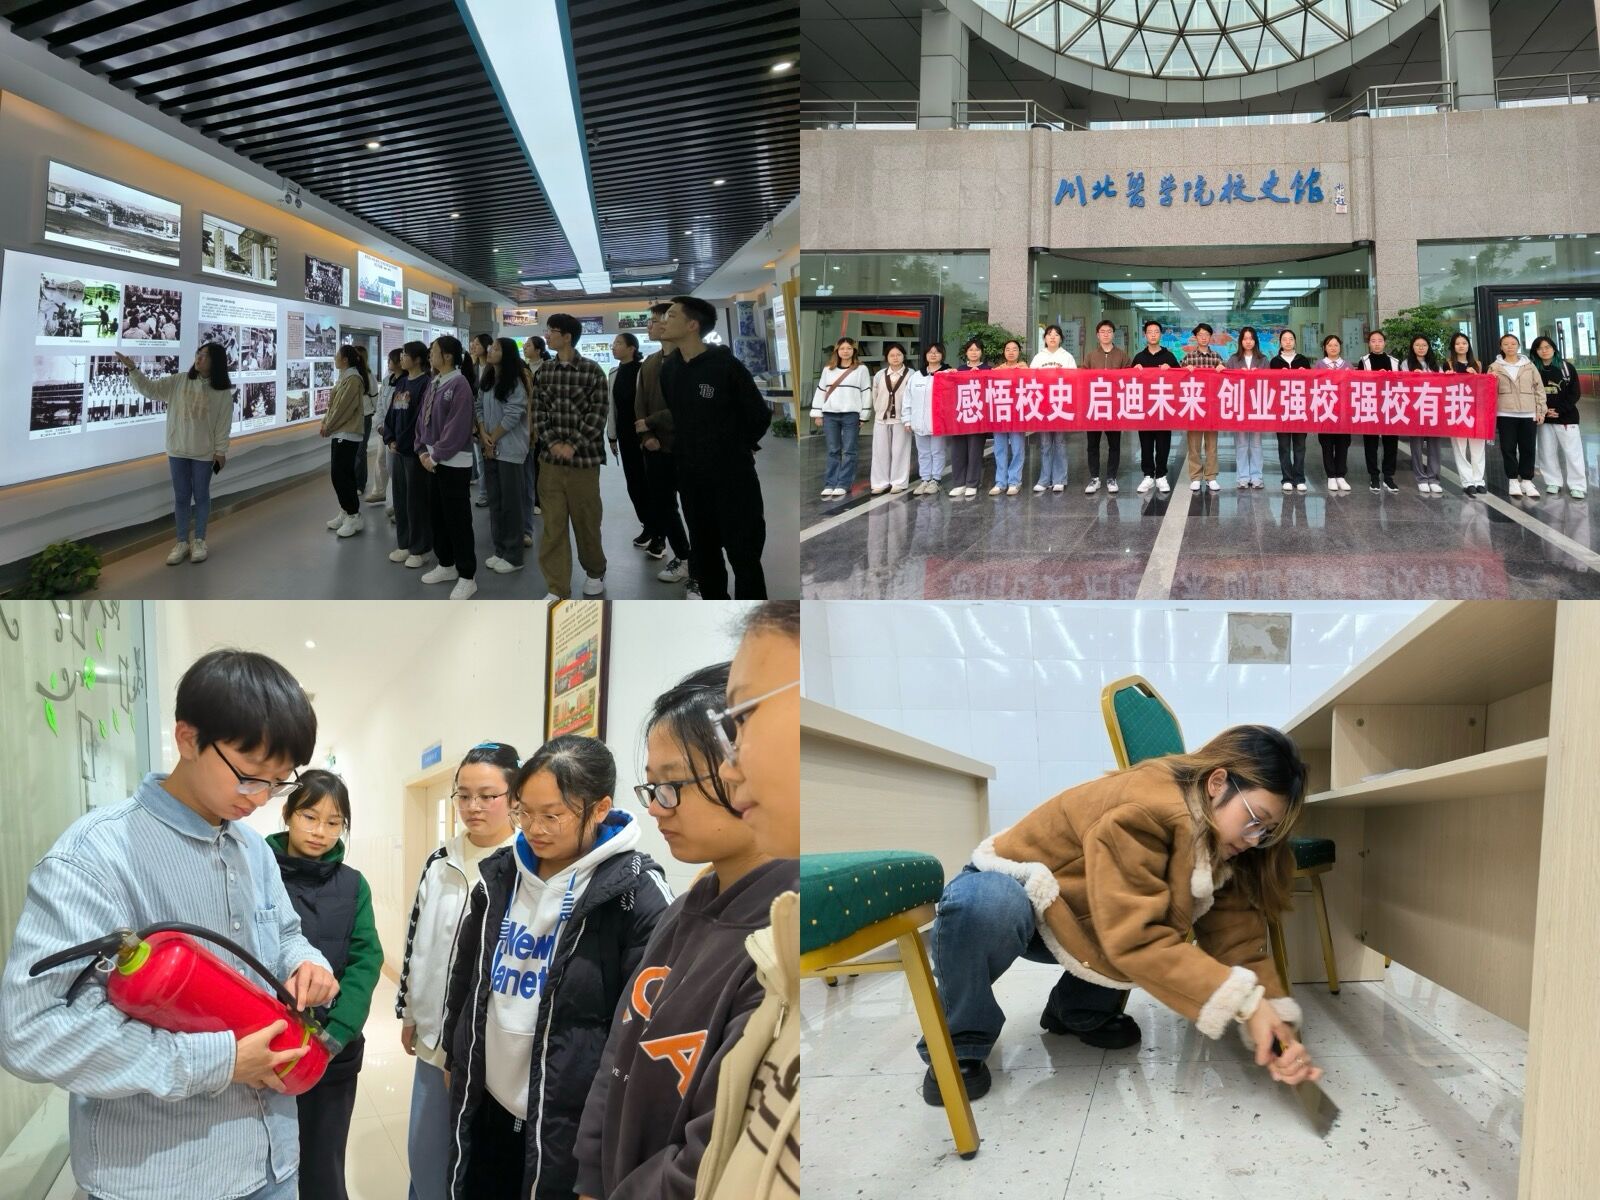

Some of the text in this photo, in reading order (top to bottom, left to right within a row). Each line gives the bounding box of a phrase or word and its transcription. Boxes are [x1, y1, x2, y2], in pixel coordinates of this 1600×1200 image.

[956, 376, 1476, 428] 感悟校史 启迪未来 创业强校 强校有我
